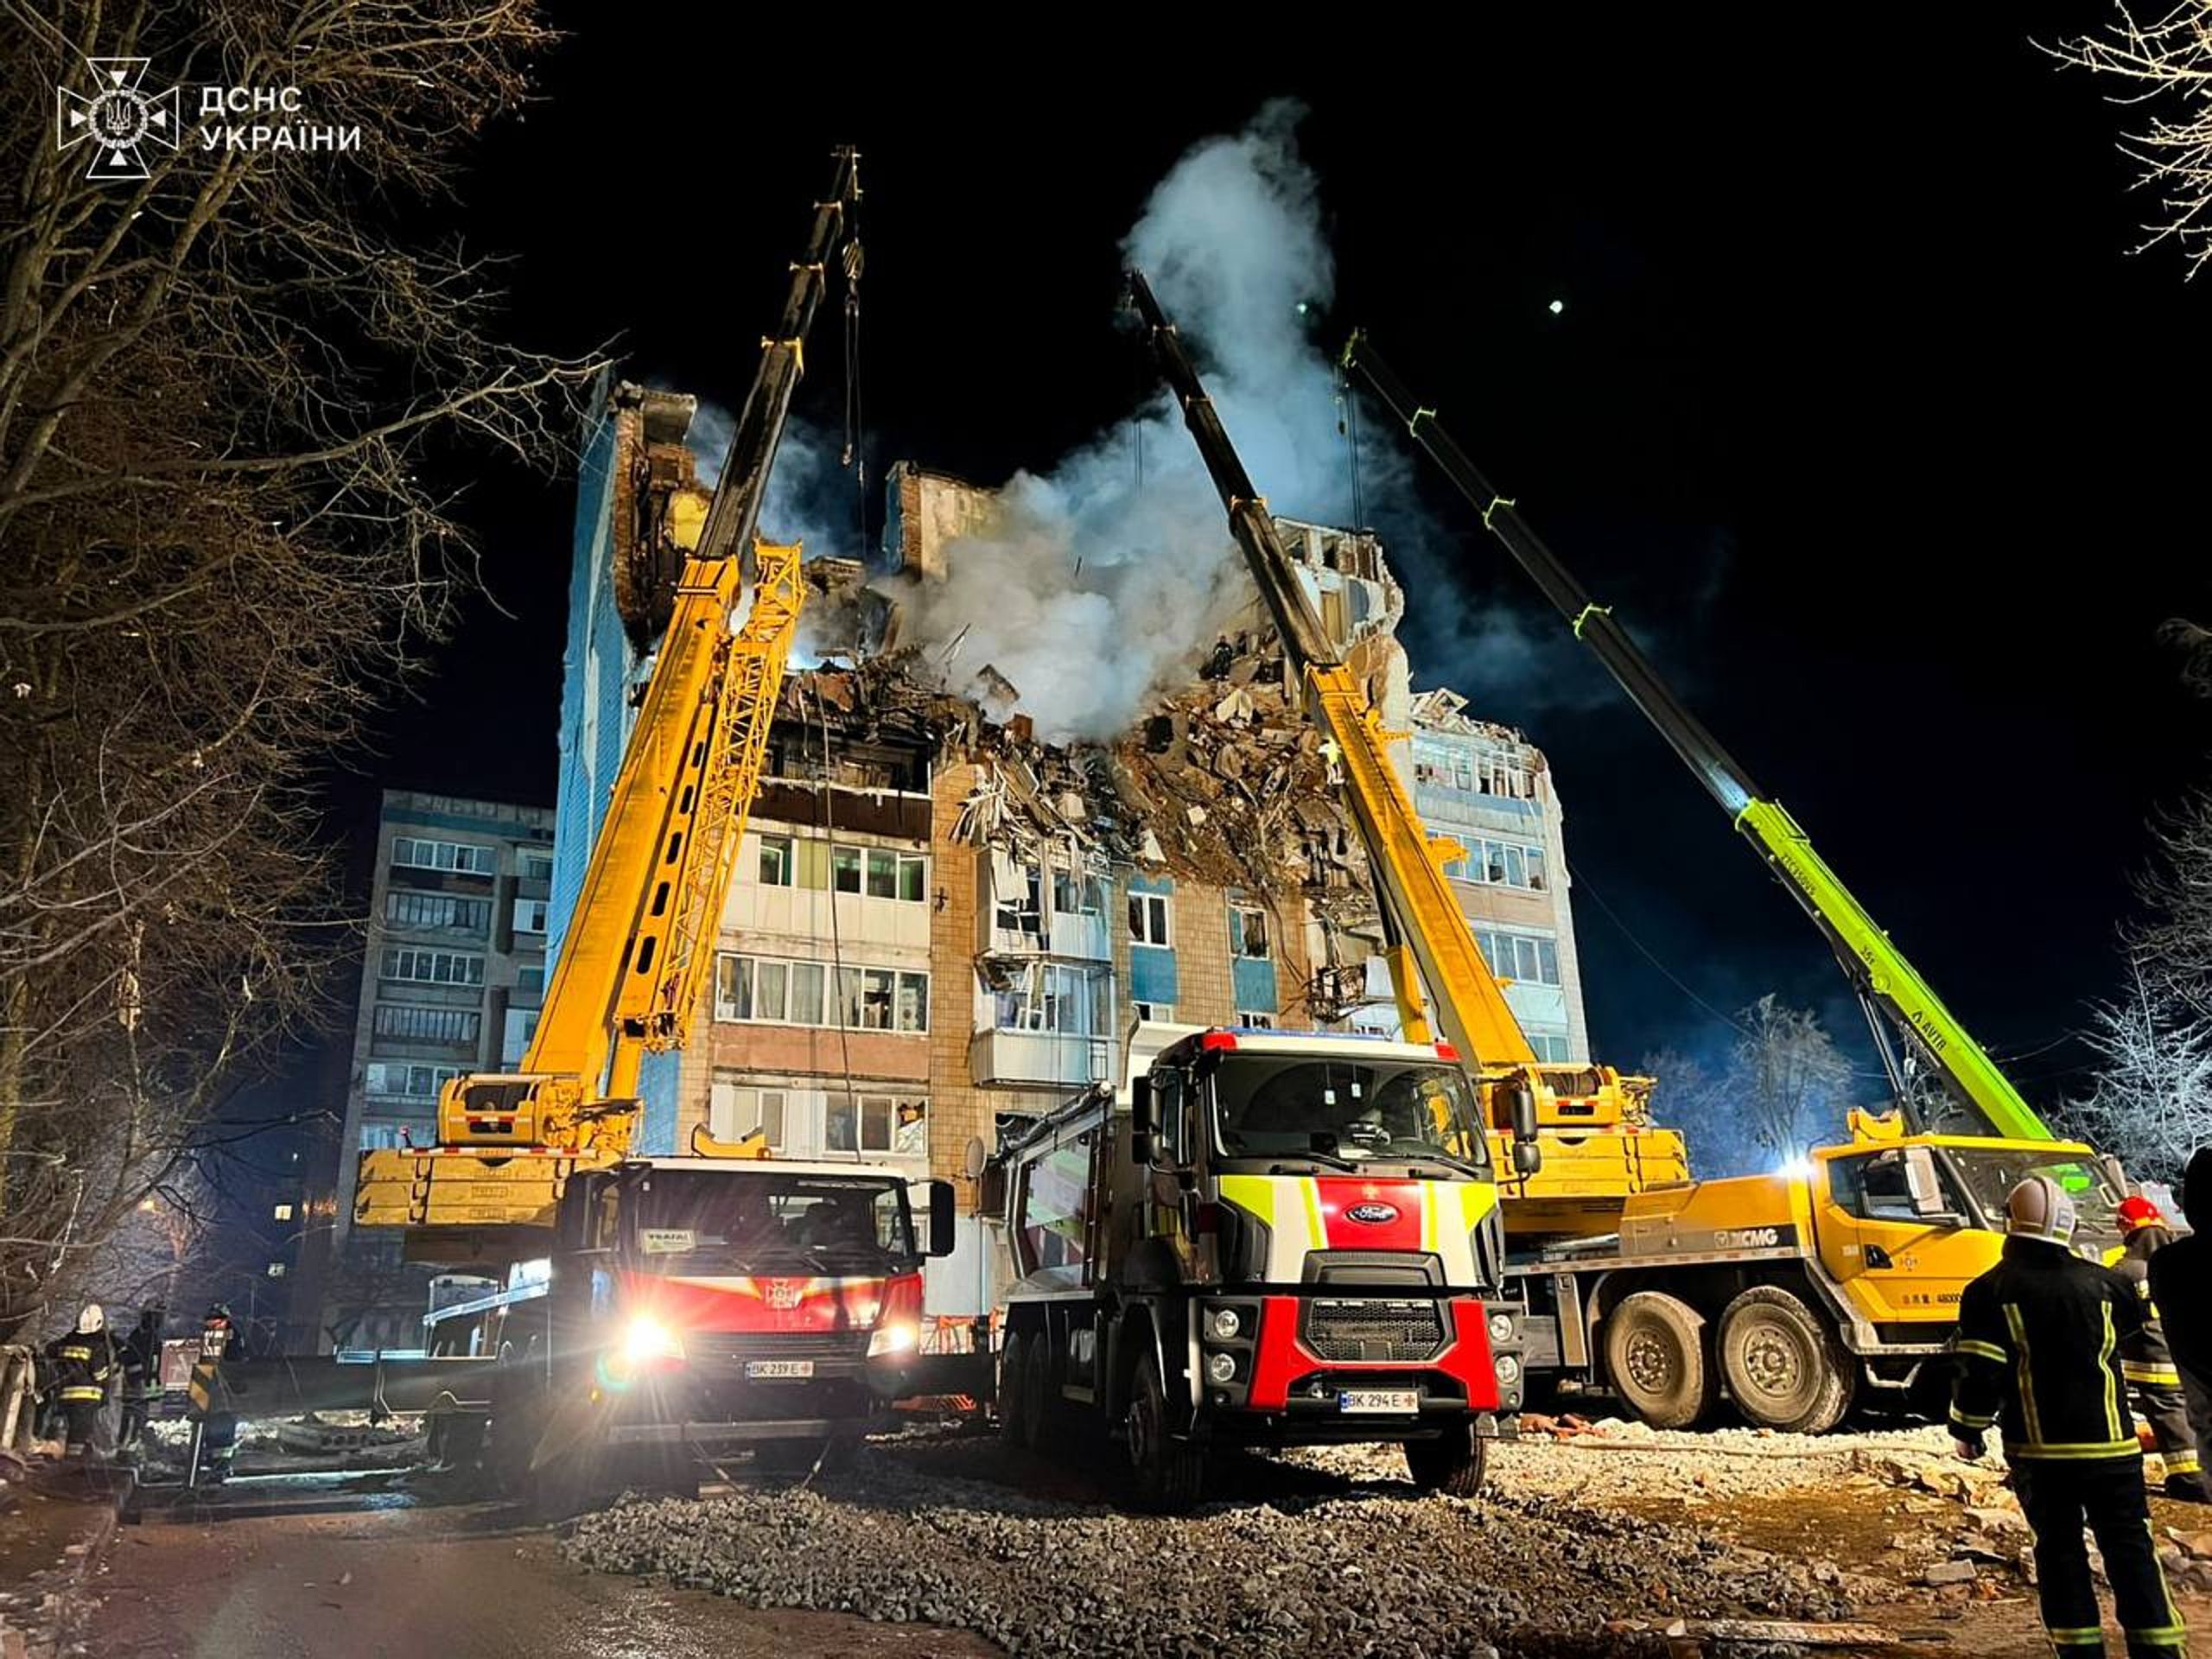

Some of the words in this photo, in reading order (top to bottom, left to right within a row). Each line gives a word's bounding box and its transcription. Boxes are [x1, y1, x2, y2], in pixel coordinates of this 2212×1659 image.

[1348, 1394, 1364, 1408] BK
[1368, 1394, 1389, 1408] 294
[1392, 1394, 1401, 1408] E
